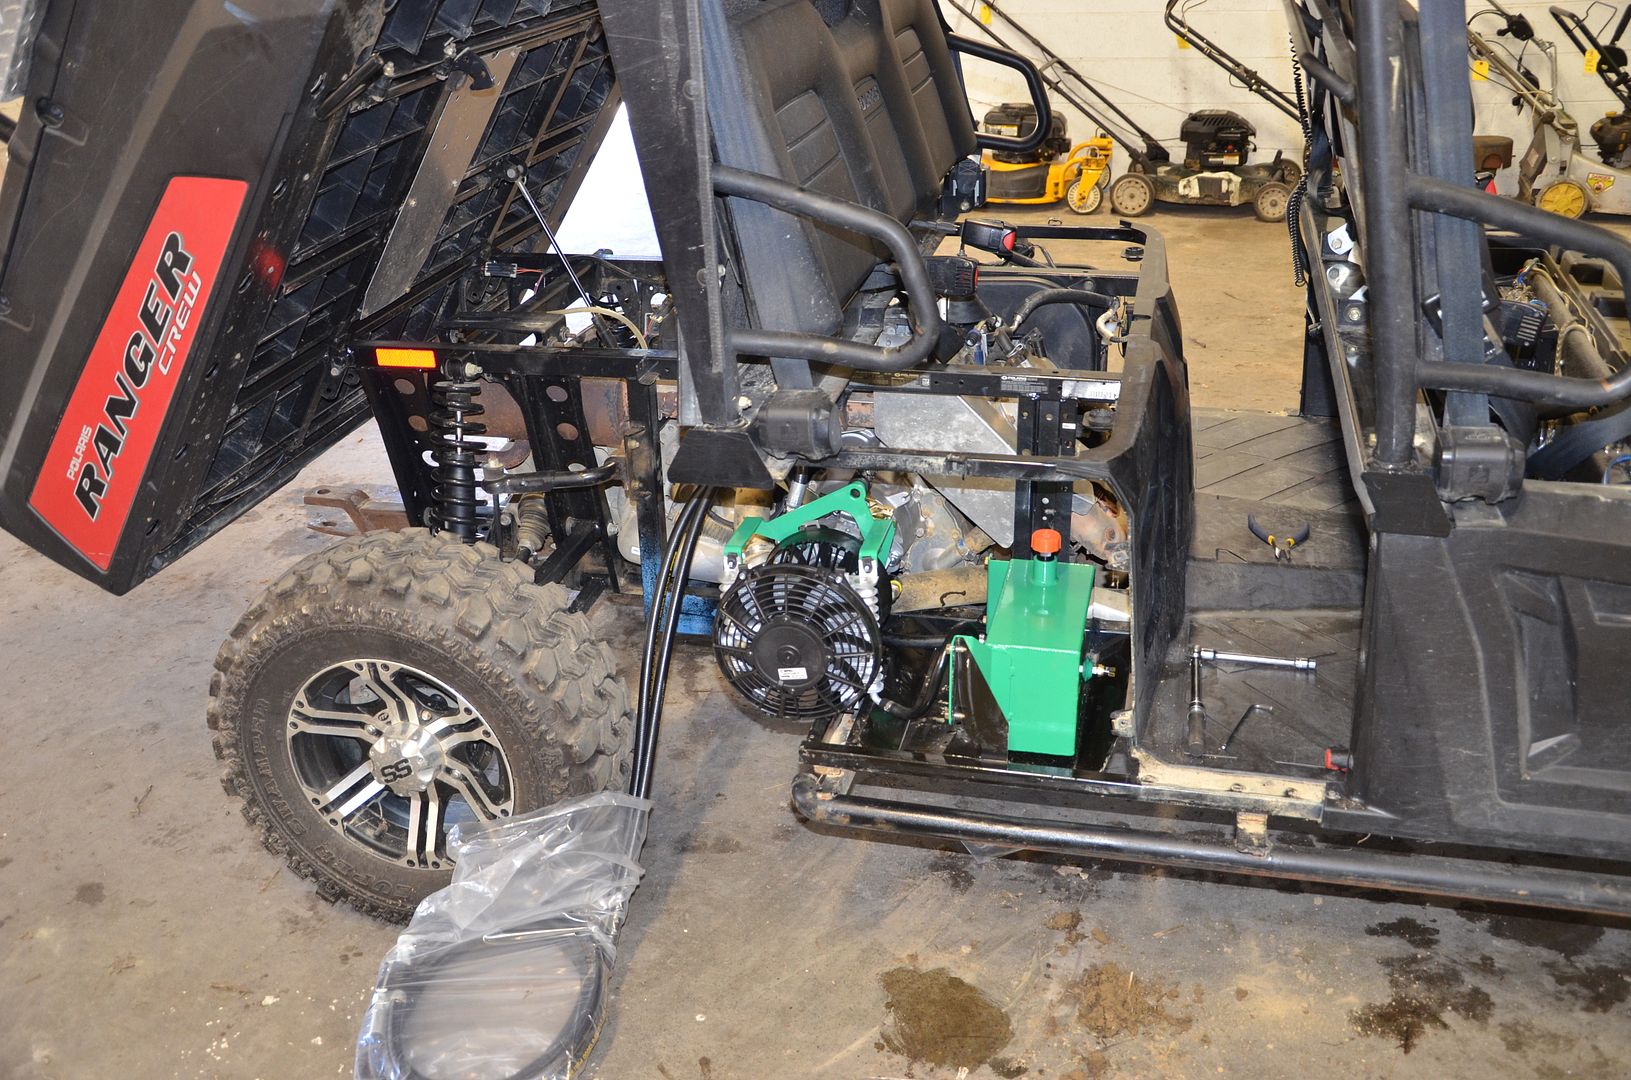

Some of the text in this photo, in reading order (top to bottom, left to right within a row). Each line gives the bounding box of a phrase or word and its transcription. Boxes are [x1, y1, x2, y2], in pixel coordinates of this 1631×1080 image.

[158, 270, 202, 376] CREW
[74, 231, 194, 523] RANGER
[66, 424, 93, 481] POLARIS
[380, 758, 413, 784] SS
